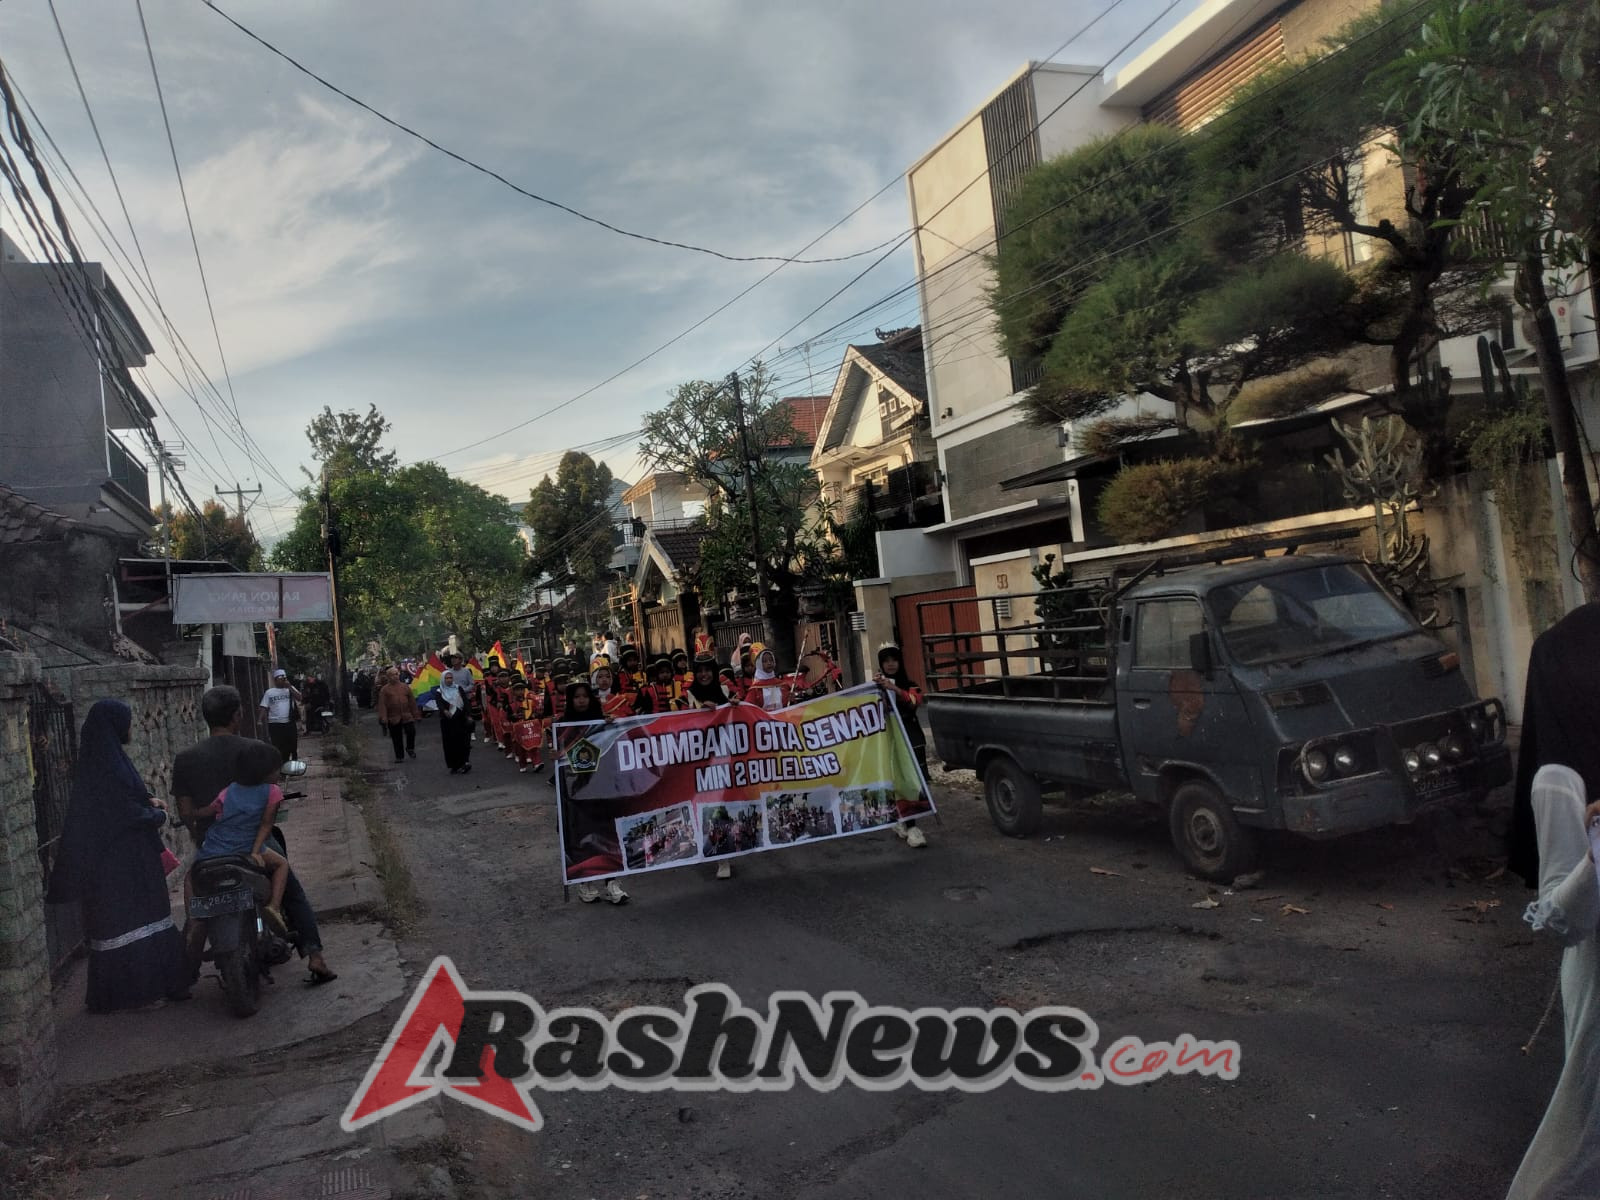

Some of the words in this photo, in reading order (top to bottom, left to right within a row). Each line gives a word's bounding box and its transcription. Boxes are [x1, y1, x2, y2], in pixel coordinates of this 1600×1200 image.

[617, 721, 750, 772] DRUMBAND
[755, 720, 803, 753] GITA
[695, 765, 732, 793] MIN
[735, 760, 747, 787] 2
[748, 752, 841, 784] BULELENG
